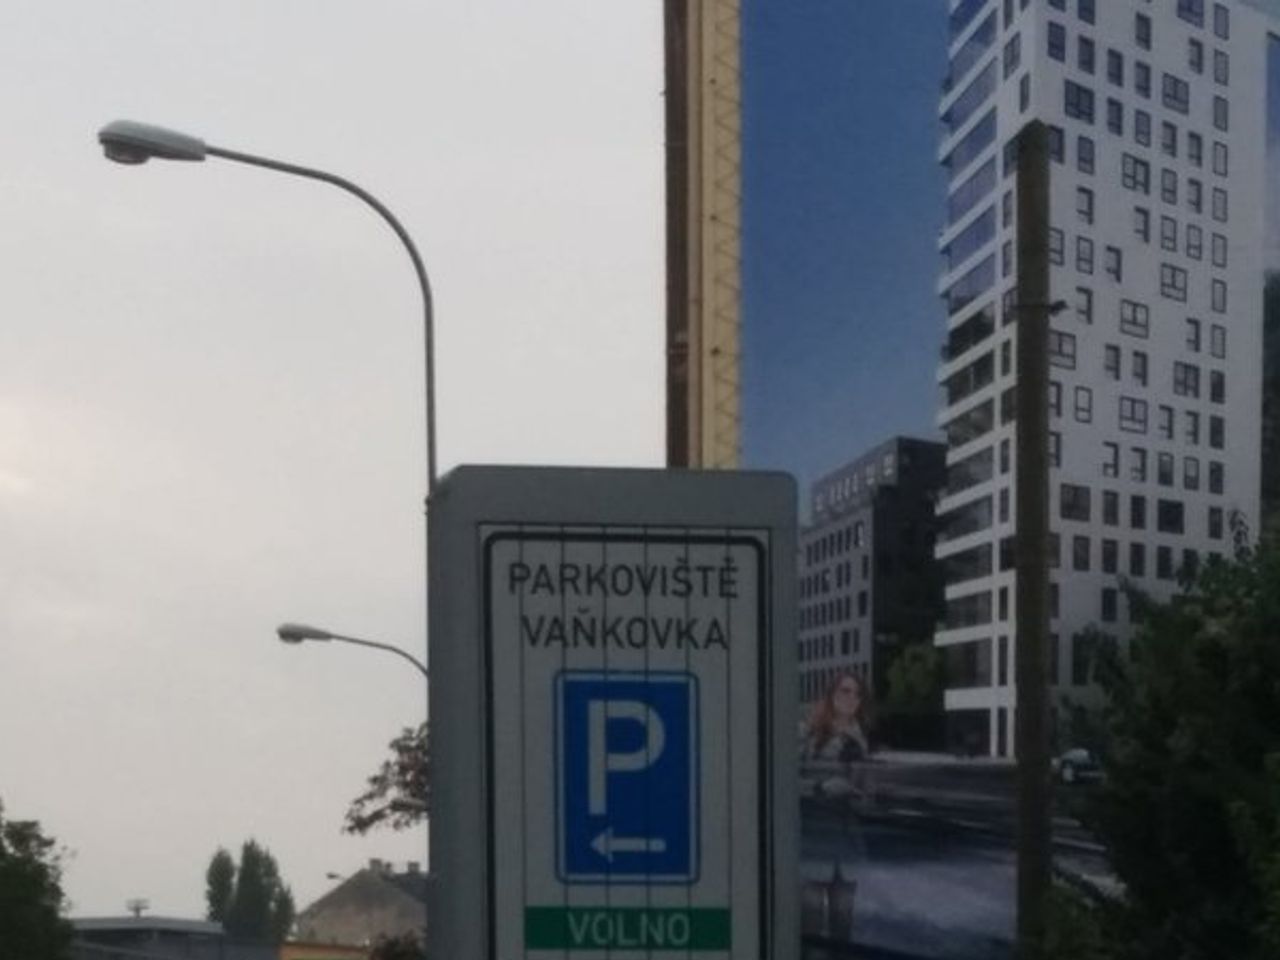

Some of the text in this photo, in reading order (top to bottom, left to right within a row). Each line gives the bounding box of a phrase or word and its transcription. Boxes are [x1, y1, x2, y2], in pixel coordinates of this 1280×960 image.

[509, 557, 738, 598] PARKOVIŠTĚ
[521, 606, 729, 649] VAŇKOVKA
[588, 699, 666, 814] P
[567, 911, 690, 946] VOLNO
